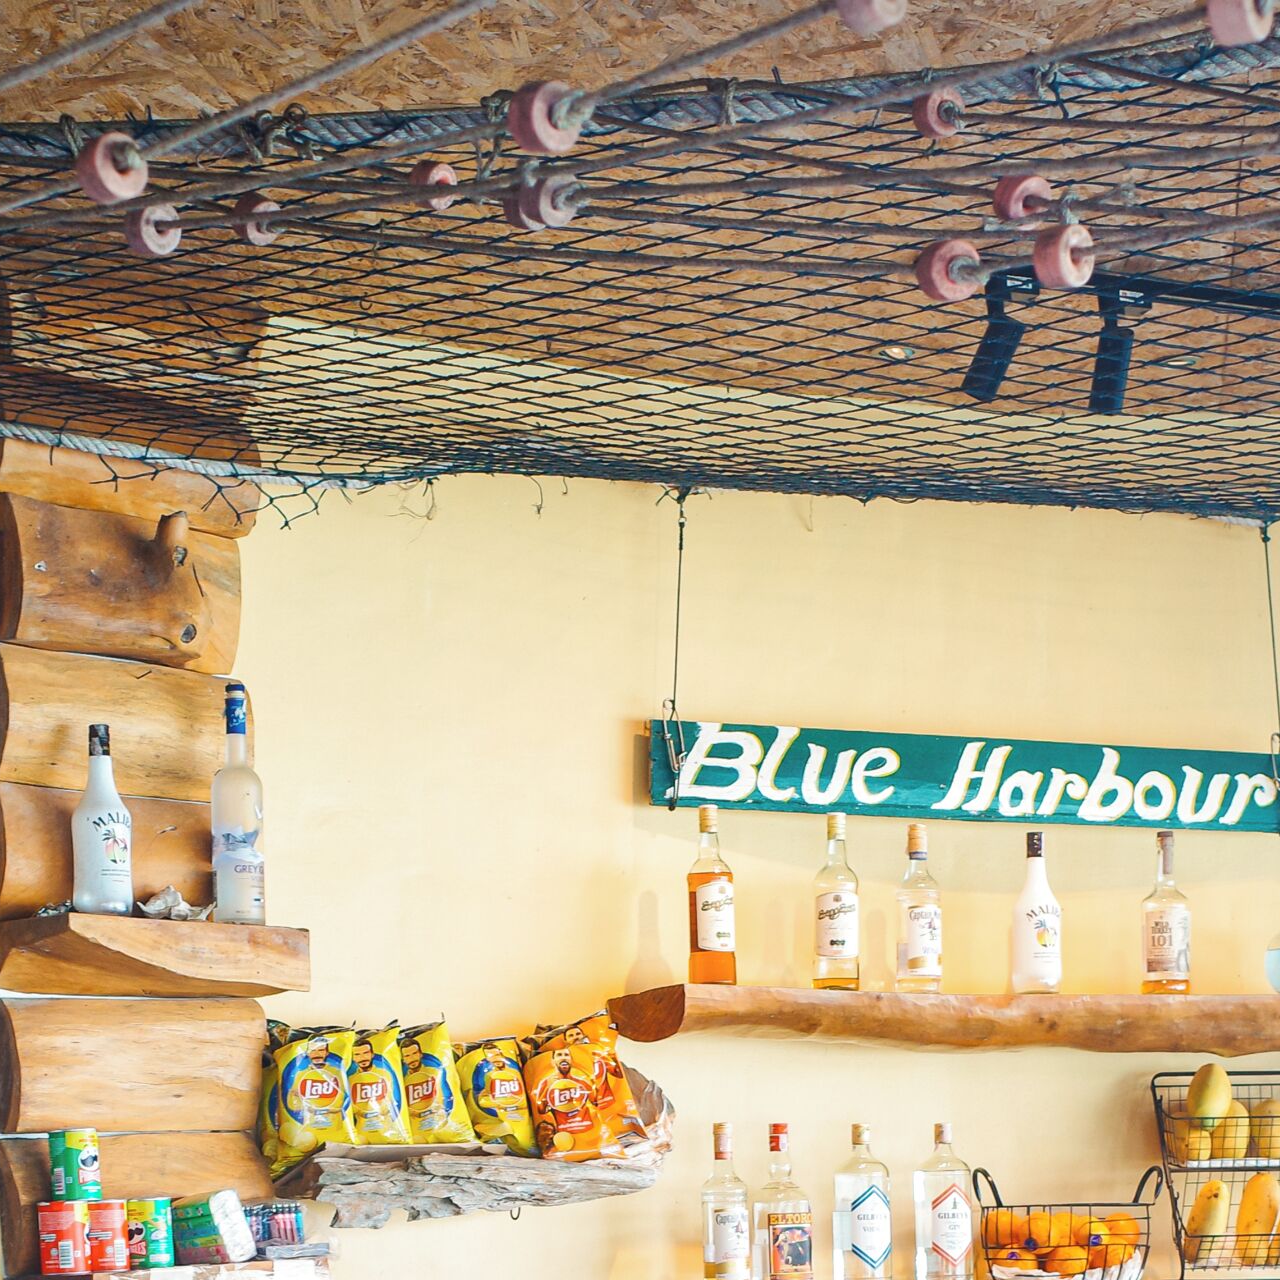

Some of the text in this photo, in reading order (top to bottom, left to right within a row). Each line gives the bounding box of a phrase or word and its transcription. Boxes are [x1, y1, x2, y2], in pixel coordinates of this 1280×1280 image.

[664, 721, 1277, 825] Blue Harbour
[234, 864, 258, 874] GREY
[1151, 935, 1173, 947] 101
